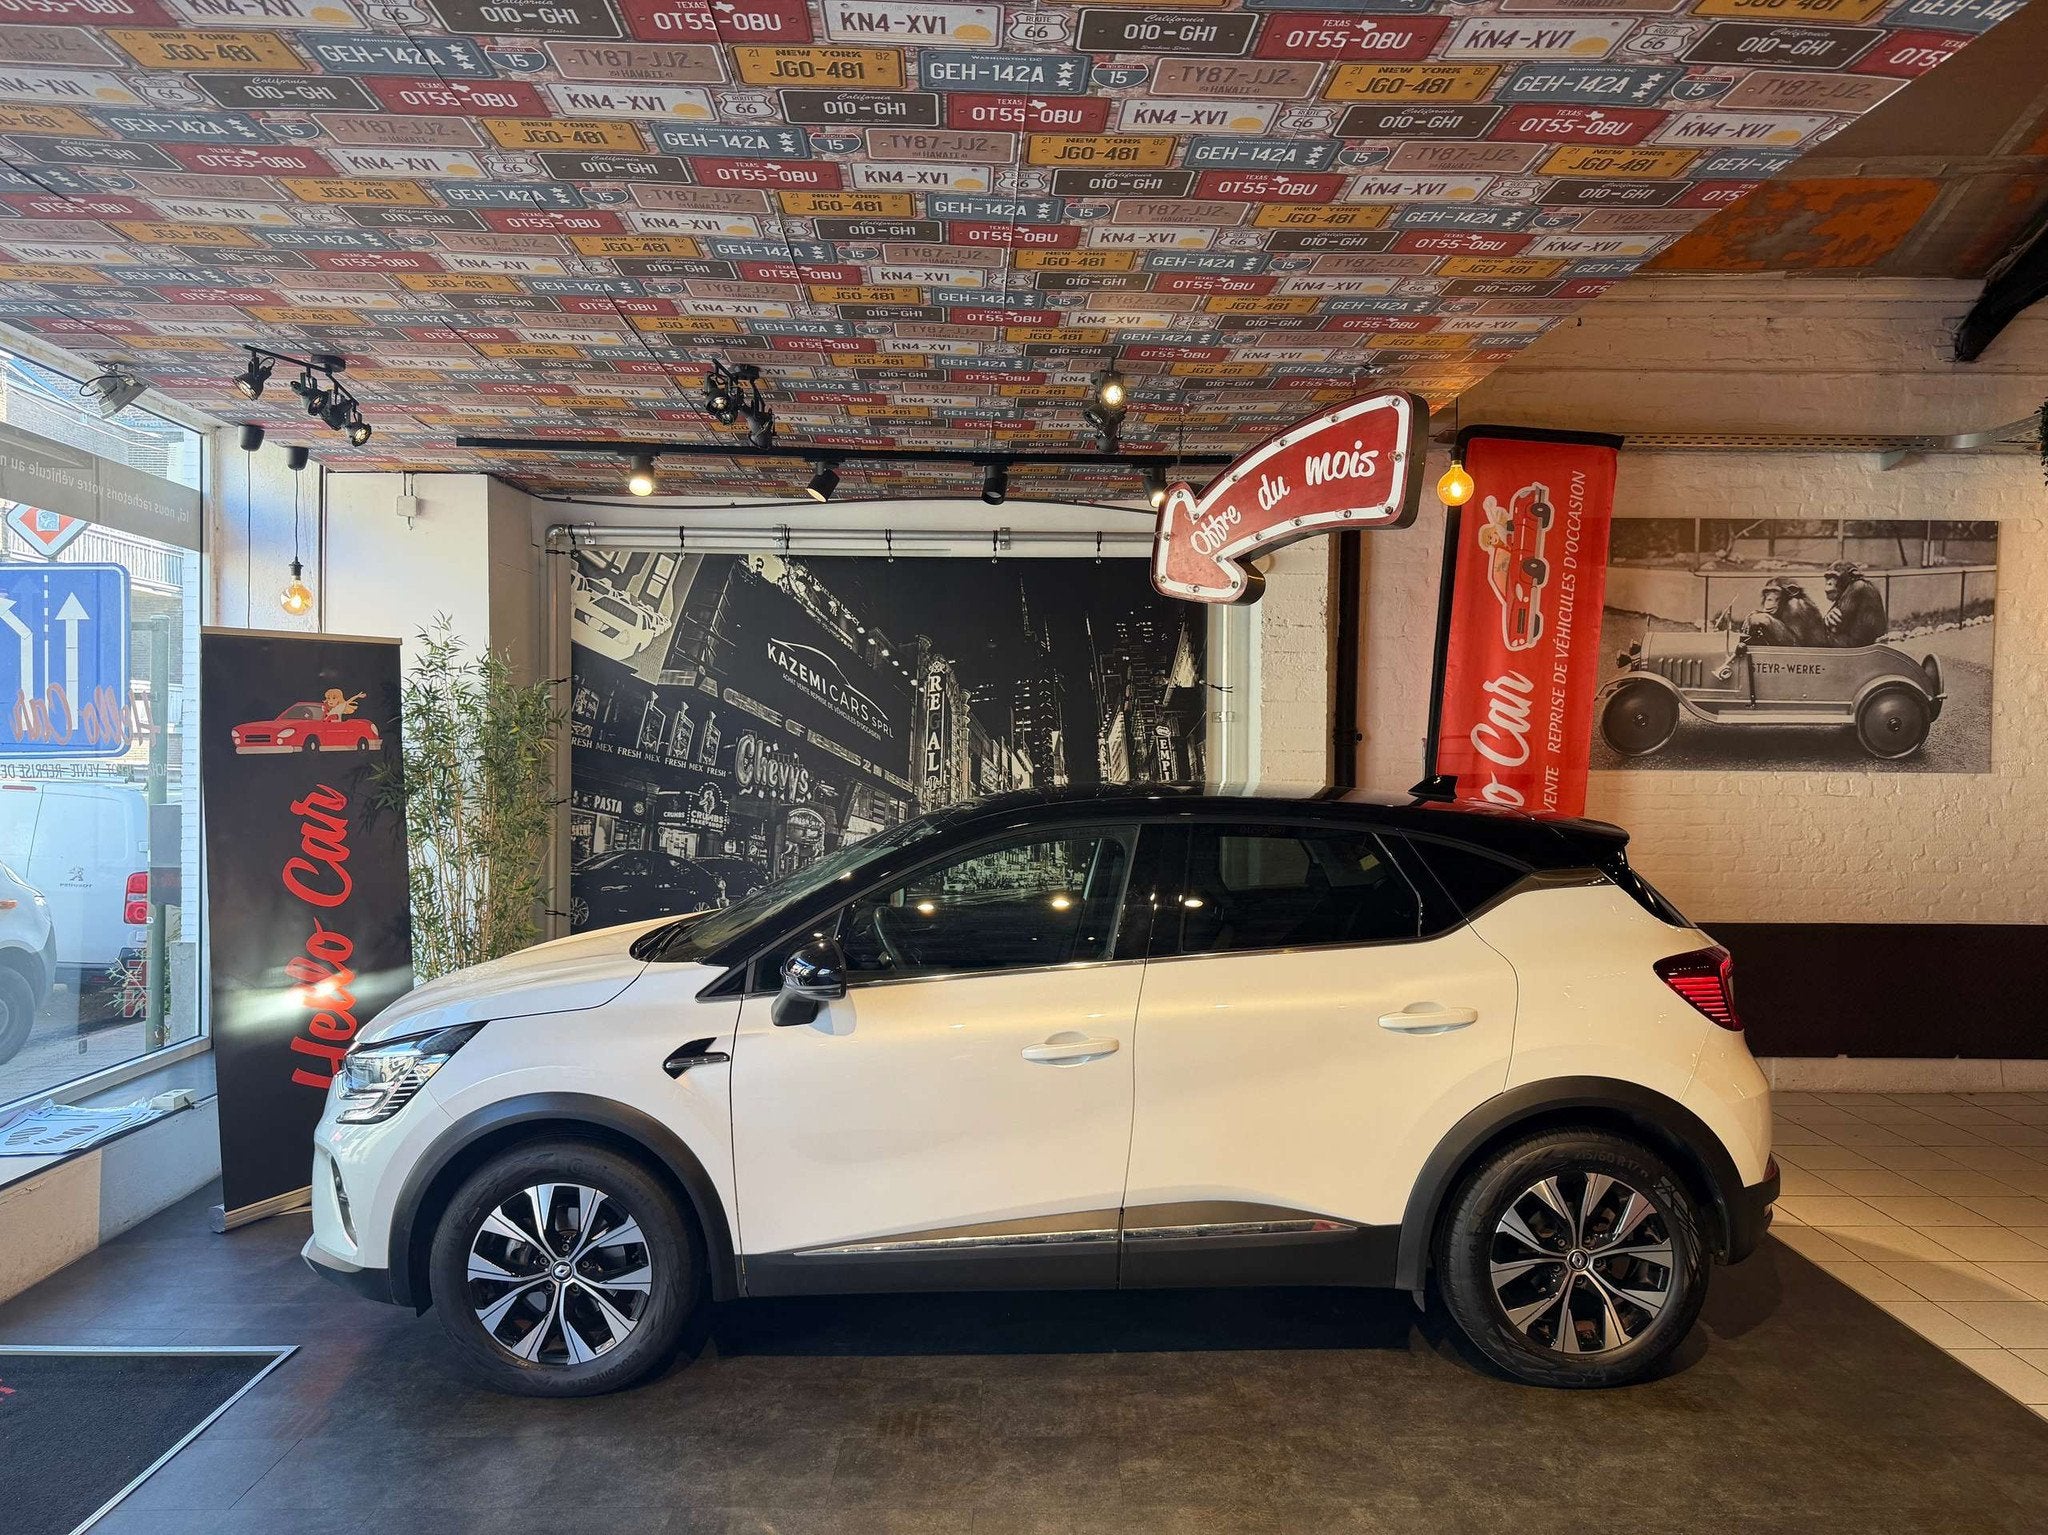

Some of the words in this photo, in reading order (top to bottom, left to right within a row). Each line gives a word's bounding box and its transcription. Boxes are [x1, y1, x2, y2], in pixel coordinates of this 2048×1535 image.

[1024, 15, 1051, 23] ROUTE
[1143, 13, 1204, 23] California
[1322, 19, 1351, 27] TEXAS
[1024, 24, 1048, 38] 66
[1649, 27, 1681, 35] ROUTE
[1769, 27, 1831, 37] California
[1639, 36, 1668, 50] 66
[316, 45, 447, 65] GEH-142A
[505, 54, 529, 67] 15
[818, 50, 862, 58] YORK
[930, 63, 1044, 82] GEH-142A
[1110, 71, 1127, 83] 15
[1512, 74, 1630, 93] GEH-142A
[1684, 83, 1711, 95] 15
[157, 88, 185, 100] 66
[837, 93, 891, 101] California
[735, 102, 757, 114] 66
[1291, 117, 1314, 127] 66
[662, 133, 770, 149] GEH-142A
[827, 139, 844, 150] 15
[1195, 146, 1297, 161] GEH-142A
[1352, 152, 1371, 162] 15
[445, 188, 548, 202] GEH-142A
[934, 202, 1026, 215] GEH-142A
[1404, 211, 1497, 223] GEH-142A
[1151, 257, 1235, 267] GEH-142A
[1121, 333, 1192, 341] GEH-142A
[1190, 504, 1242, 556] Offre
[1257, 473, 1291, 511] du
[1305, 440, 1379, 486] mois
[1555, 573, 1577, 660] VÉHICULES
[1553, 661, 1568, 684] DE
[767, 642, 827, 695] KAZEMI
[829, 684, 869, 721] CARS
[871, 716, 894, 739] SPRL
[1470, 669, 1535, 768] Car
[1547, 687, 1567, 754] REPRISE
[571, 737, 593, 749] RESH
[596, 742, 614, 753] MEX
[617, 747, 642, 759] FRESH
[645, 753, 661, 763] MEX
[664, 757, 687, 769] FRESH
[689, 762, 704, 773] MEX
[706, 766, 727, 777] FRESH
[735, 734, 810, 804] Chevys
[1543, 764, 1560, 813] VENTE
[593, 795, 623, 814] PASTA
[690, 810, 724, 824] CRUMBS
[281, 782, 354, 907] Car
[285, 916, 357, 1089] Hello
